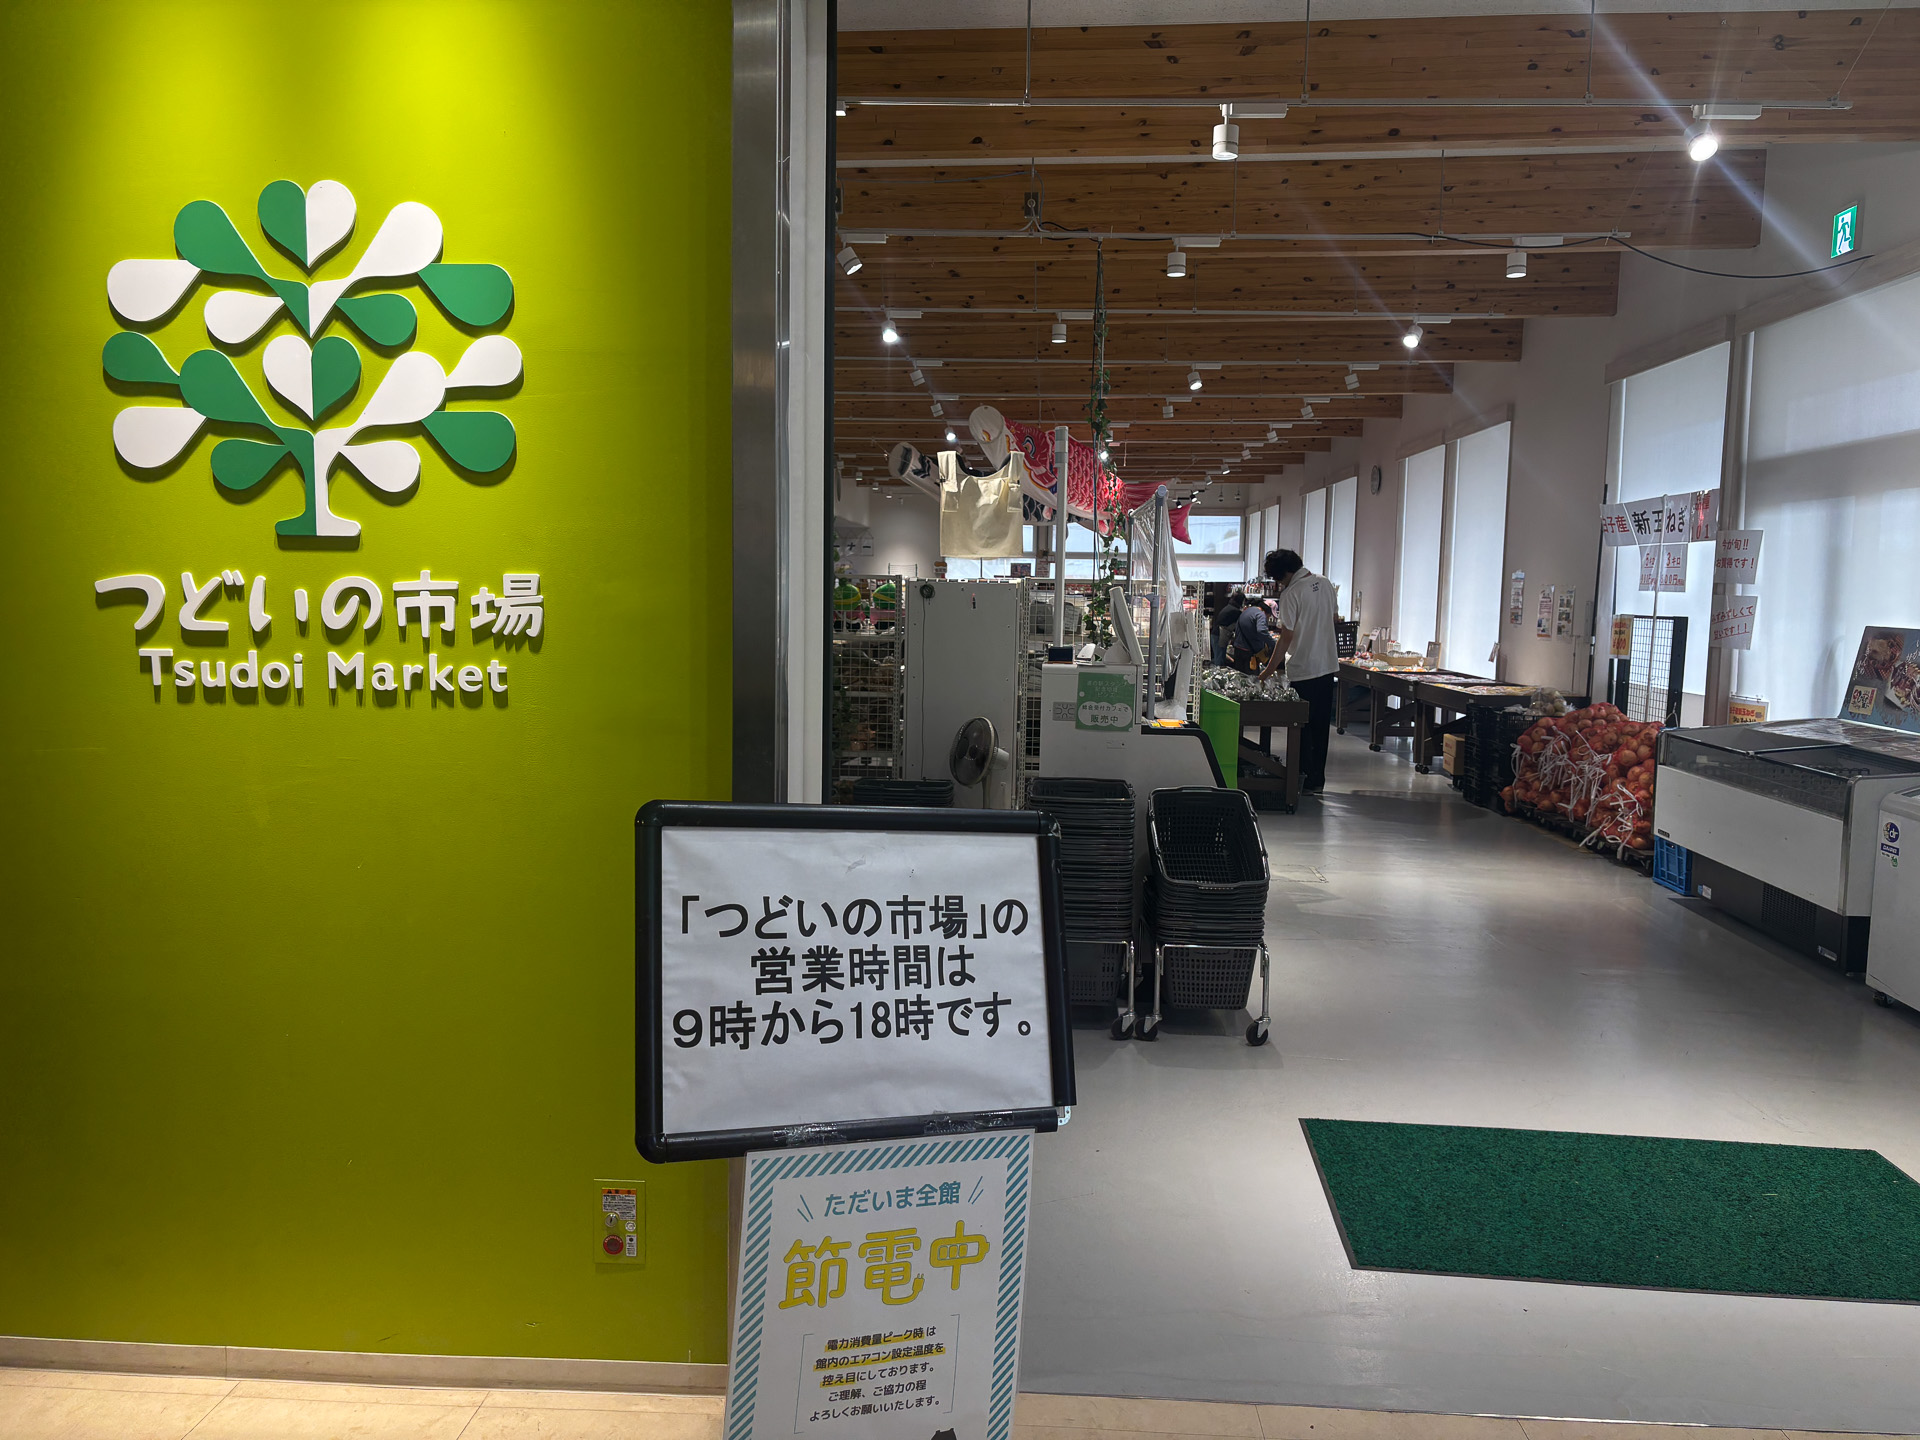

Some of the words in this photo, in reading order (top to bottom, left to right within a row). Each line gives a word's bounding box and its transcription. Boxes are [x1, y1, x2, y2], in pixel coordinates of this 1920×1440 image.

[95, 570, 544, 638] つどいの市場
[139, 648, 303, 689] Tsudoi
[328, 651, 508, 692] Market
[1090, 714, 1119, 724] 販売中
[681, 894, 1029, 940] 「つどいの市場」の
[750, 944, 976, 995] 営業時間は
[672, 992, 1031, 1051] 9時から18時です。
[824, 1181, 961, 1217] ただいま全館
[778, 1220, 990, 1310] 節電中
[815, 1342, 944, 1370] 館内のエアコン設定温度を
[822, 1361, 934, 1387] 控え目にしております。
[809, 1395, 940, 1422] よろしくお願いいたします。
[828, 1379, 927, 1402] ご理解、ご協力の程
